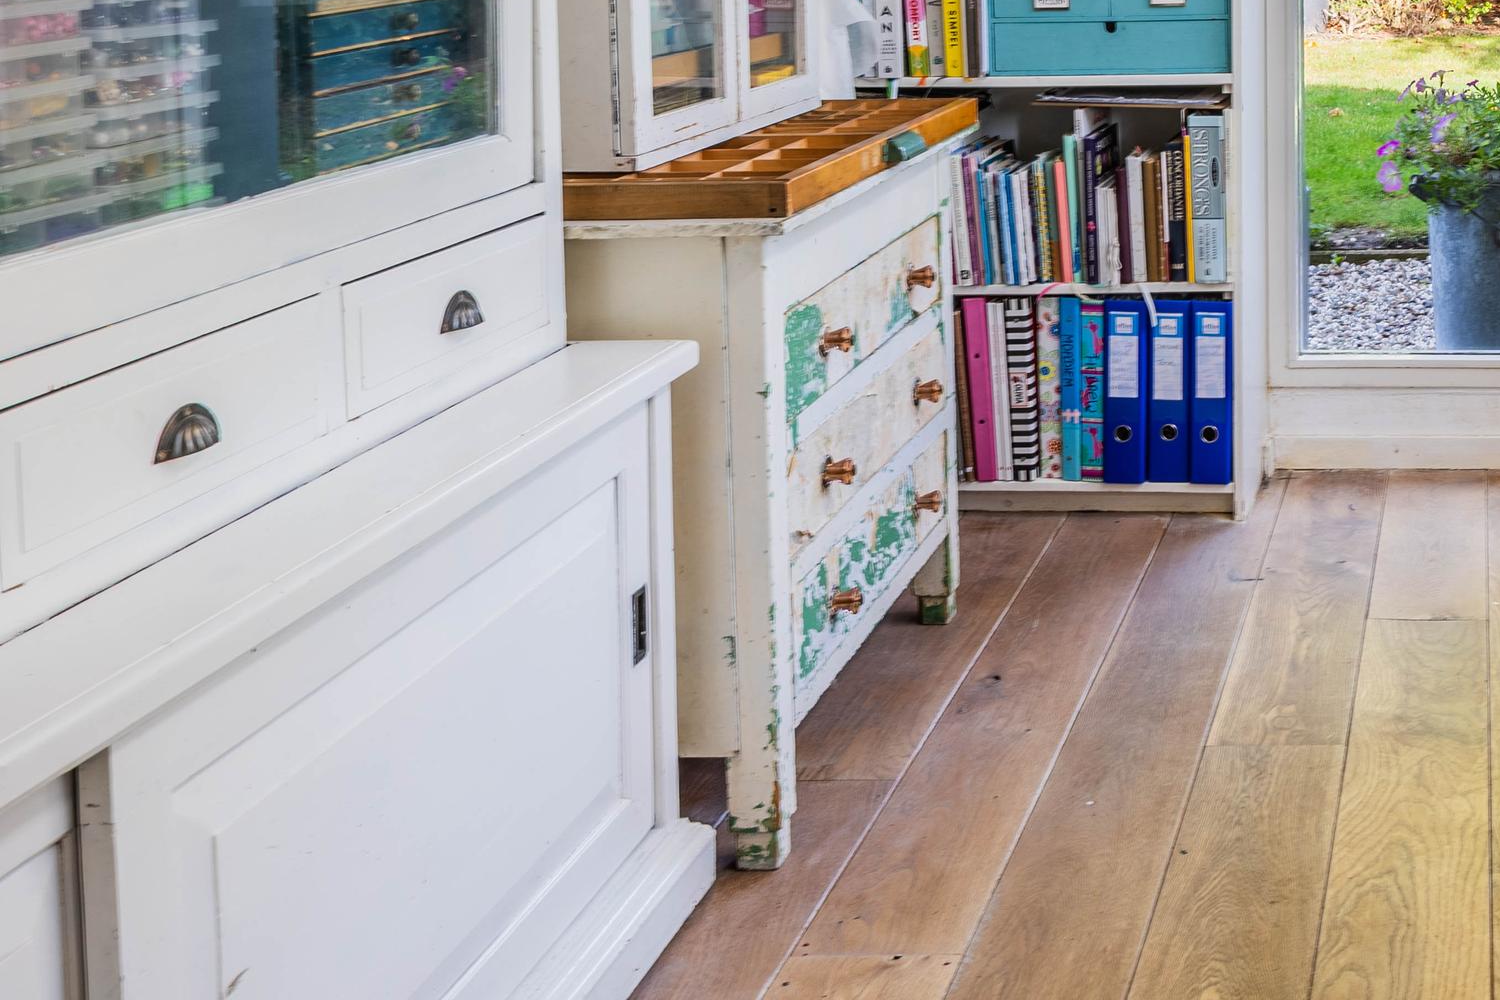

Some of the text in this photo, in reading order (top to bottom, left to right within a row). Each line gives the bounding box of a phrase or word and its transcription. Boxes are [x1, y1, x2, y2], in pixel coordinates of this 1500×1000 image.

[950, 10, 959, 48] SIMPEL
[1174, 150, 1185, 221] CONCORDANTIE
[1193, 129, 1211, 216] STRONG'S
[1013, 384, 1024, 404] OLIVIA
